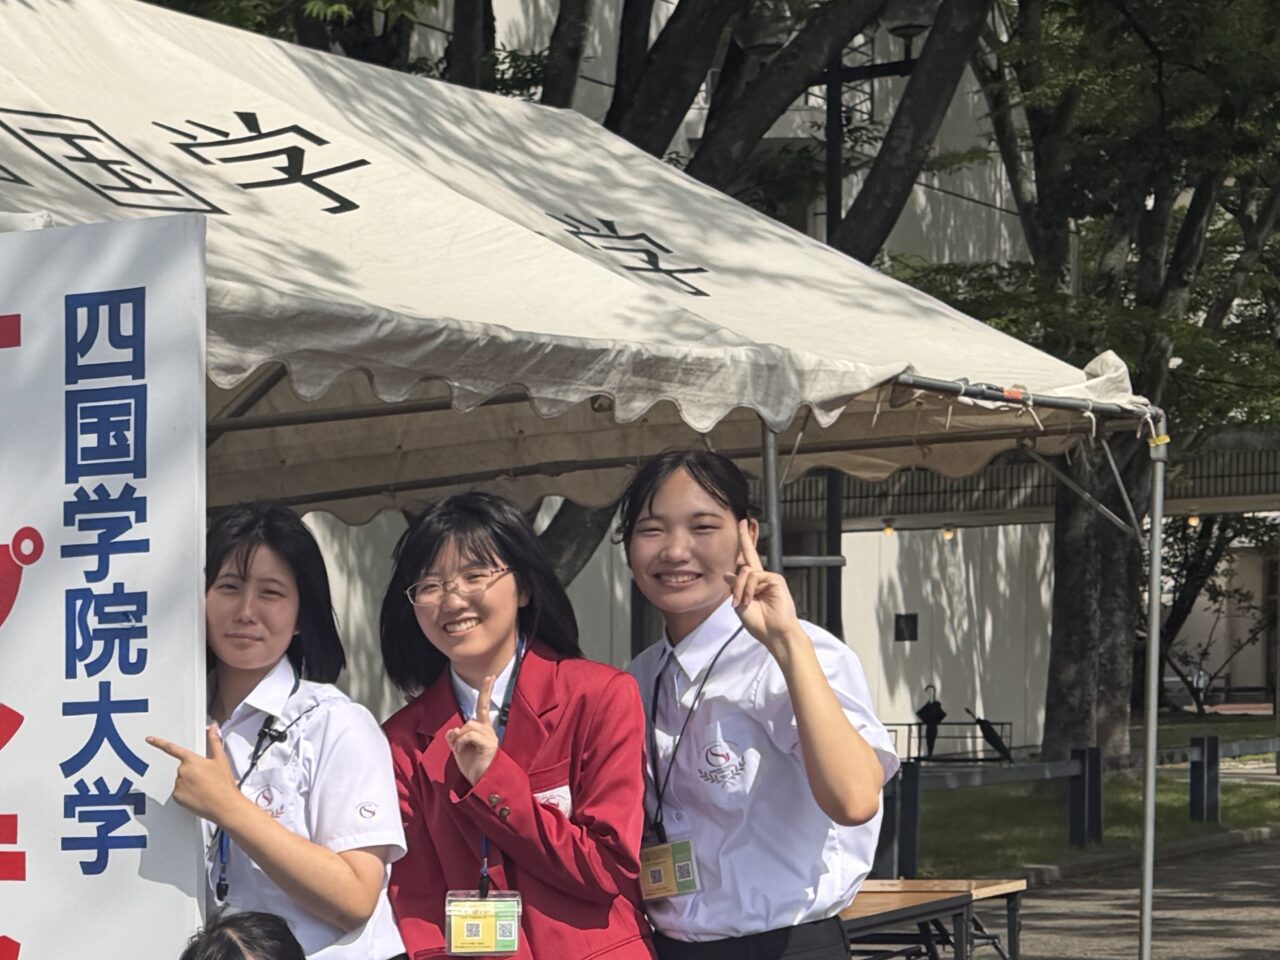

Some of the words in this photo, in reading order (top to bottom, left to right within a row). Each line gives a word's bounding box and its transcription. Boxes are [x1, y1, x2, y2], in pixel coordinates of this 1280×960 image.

[58, 285, 150, 876] 四国学院大学
